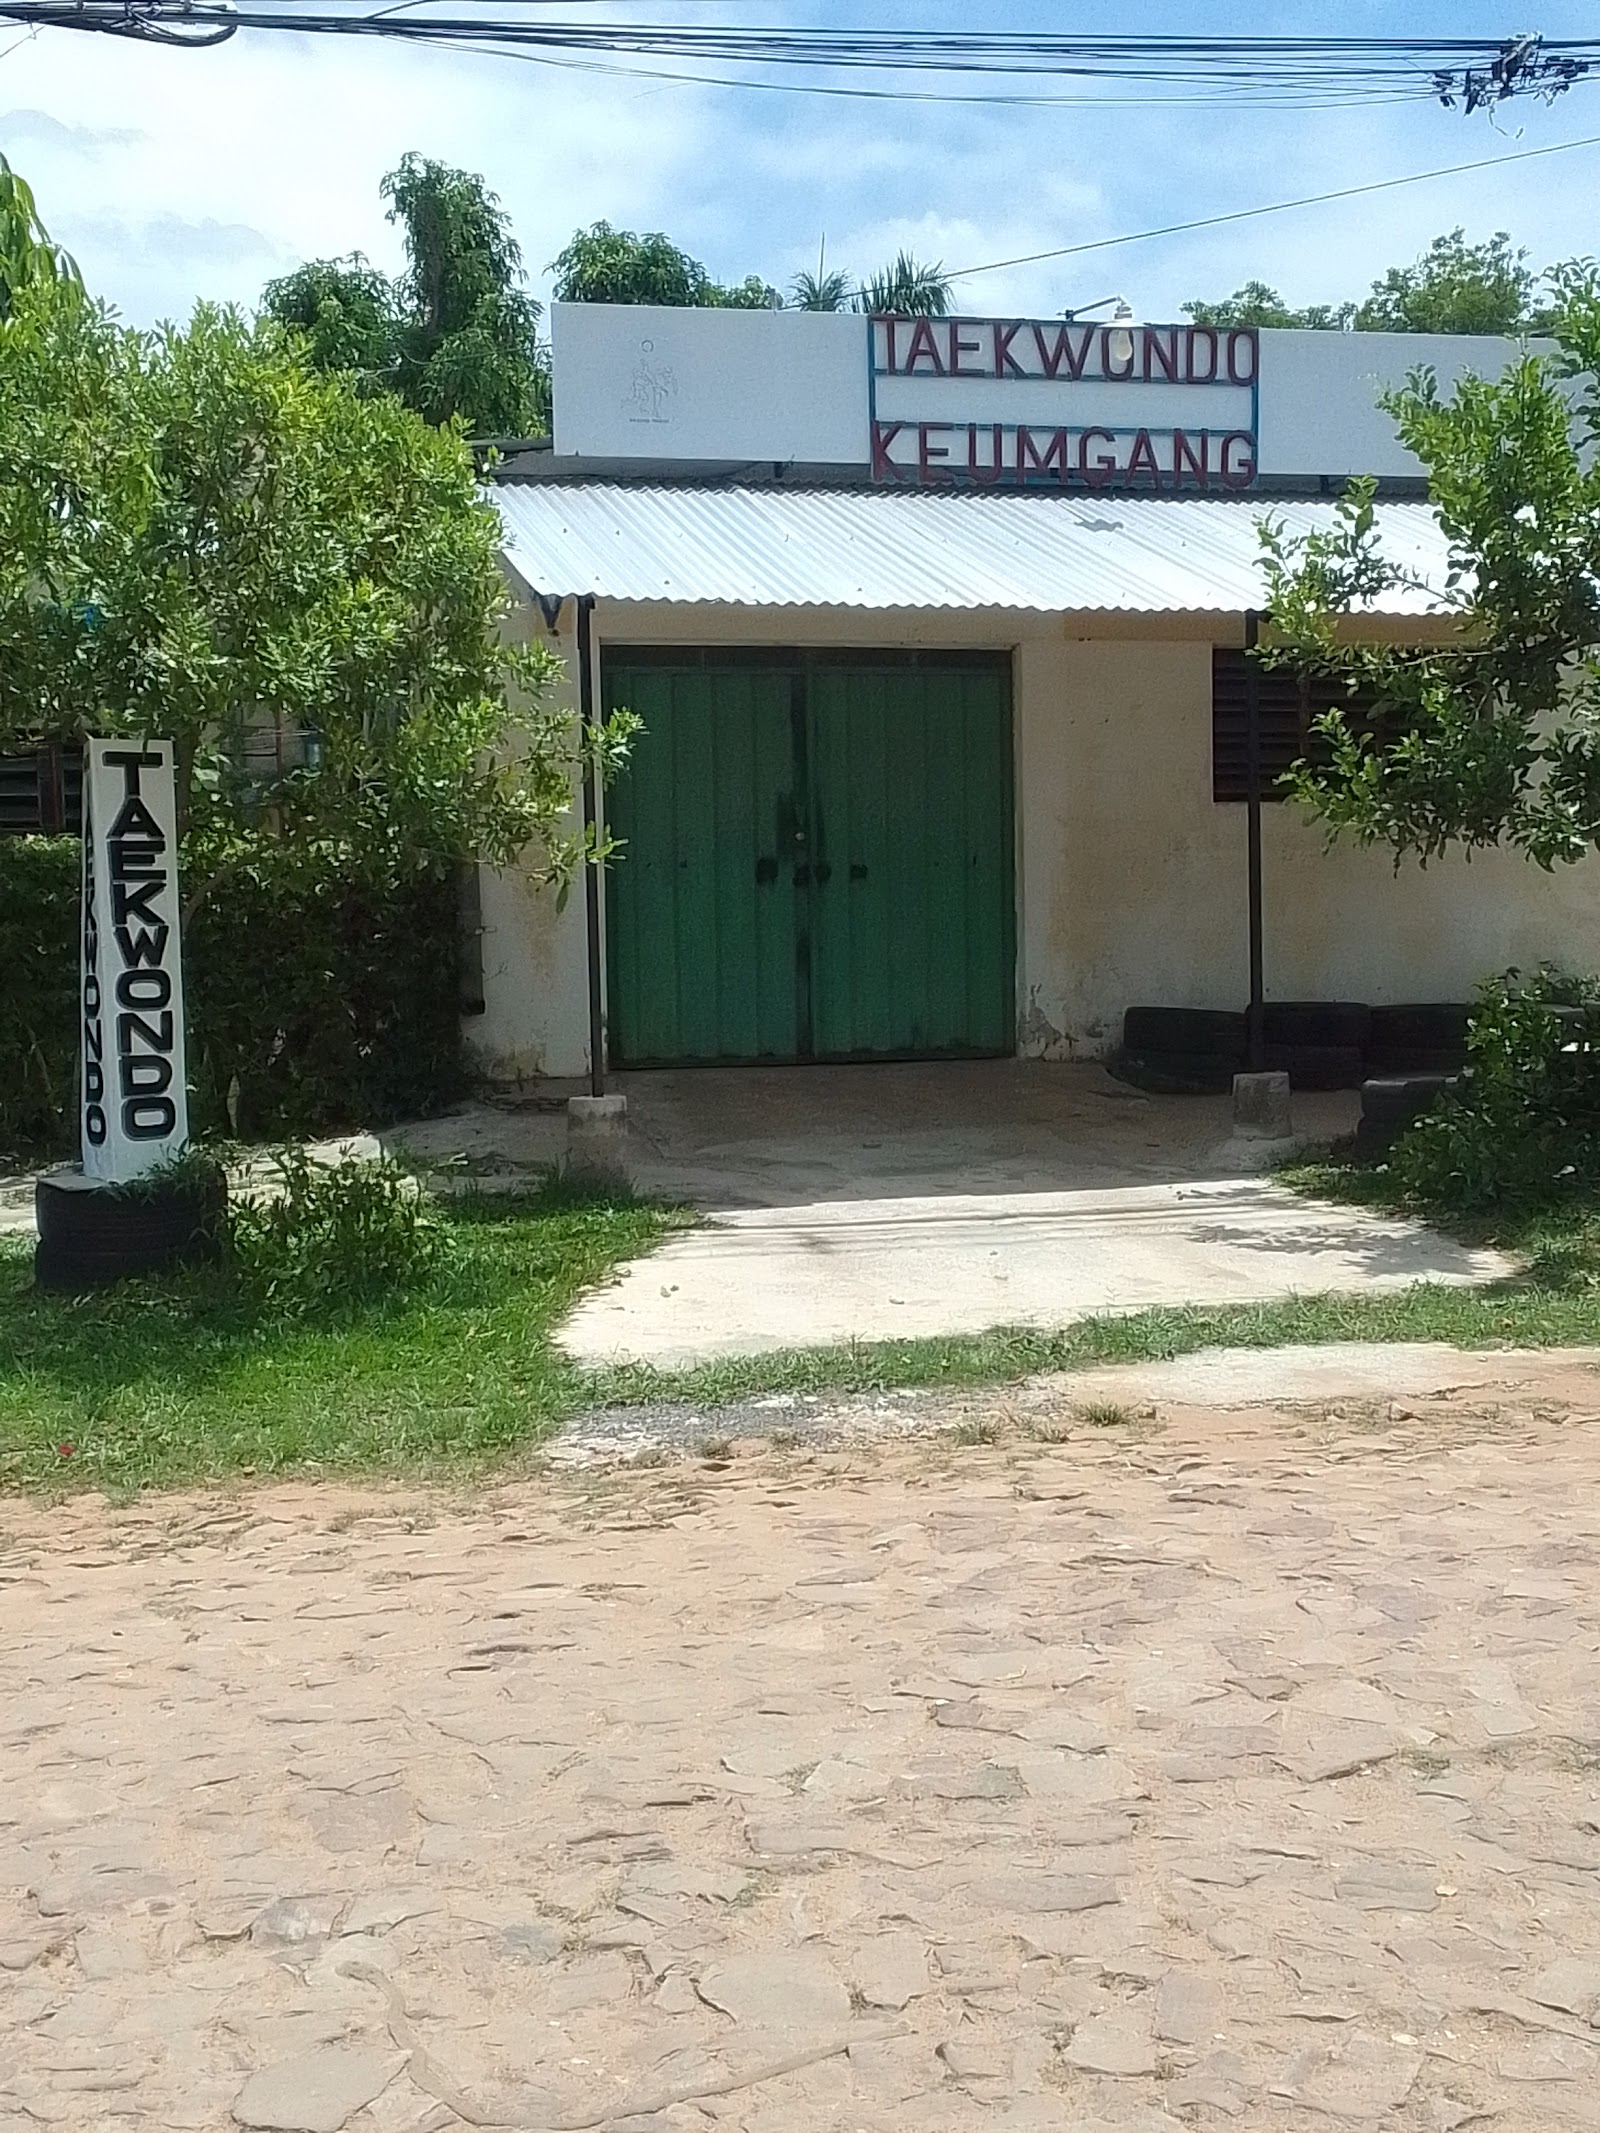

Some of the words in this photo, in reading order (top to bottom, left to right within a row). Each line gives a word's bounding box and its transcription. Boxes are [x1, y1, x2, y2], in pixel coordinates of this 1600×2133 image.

[869, 315, 1259, 387] TAEKWONDO
[871, 420, 1258, 489] KEUMGANG
[102, 750, 176, 1142] TAEKWONDO
